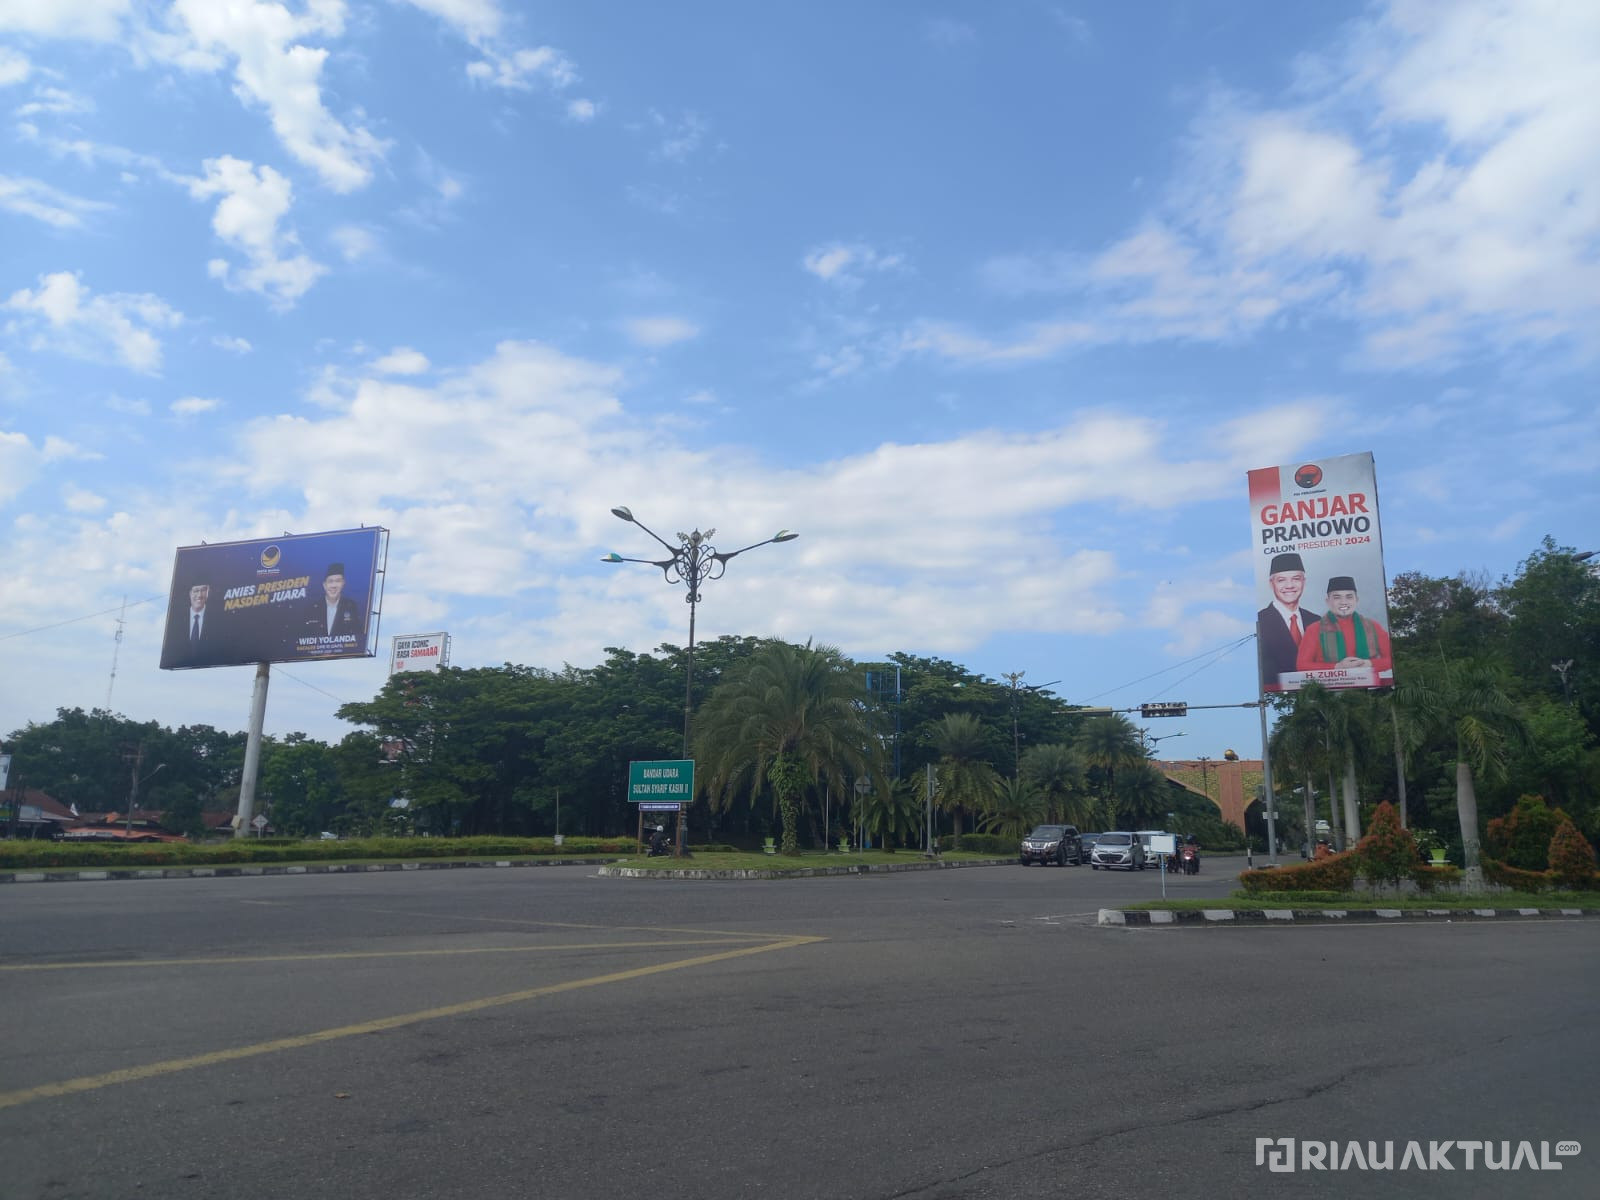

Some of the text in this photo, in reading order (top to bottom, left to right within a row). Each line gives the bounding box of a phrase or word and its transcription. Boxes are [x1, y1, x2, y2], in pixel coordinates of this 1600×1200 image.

[1261, 493, 1368, 525] GANJAR
[1262, 516, 1370, 544] PRANOWO
[1264, 536, 1370, 554] CALON PRESIDEN 2024
[224, 576, 309, 600] ANIES PRESIDEN
[224, 588, 306, 611] NASDEM JUARA
[299, 635, 356, 645] WIDI YOLANDA
[1318, 670, 1347, 679] ZUKRI
[643, 768, 679, 778] BANDAR UDARA
[633, 784, 650, 794] SULTAN
[652, 784, 667, 794] SYARIF
[669, 784, 683, 794] KASIM
